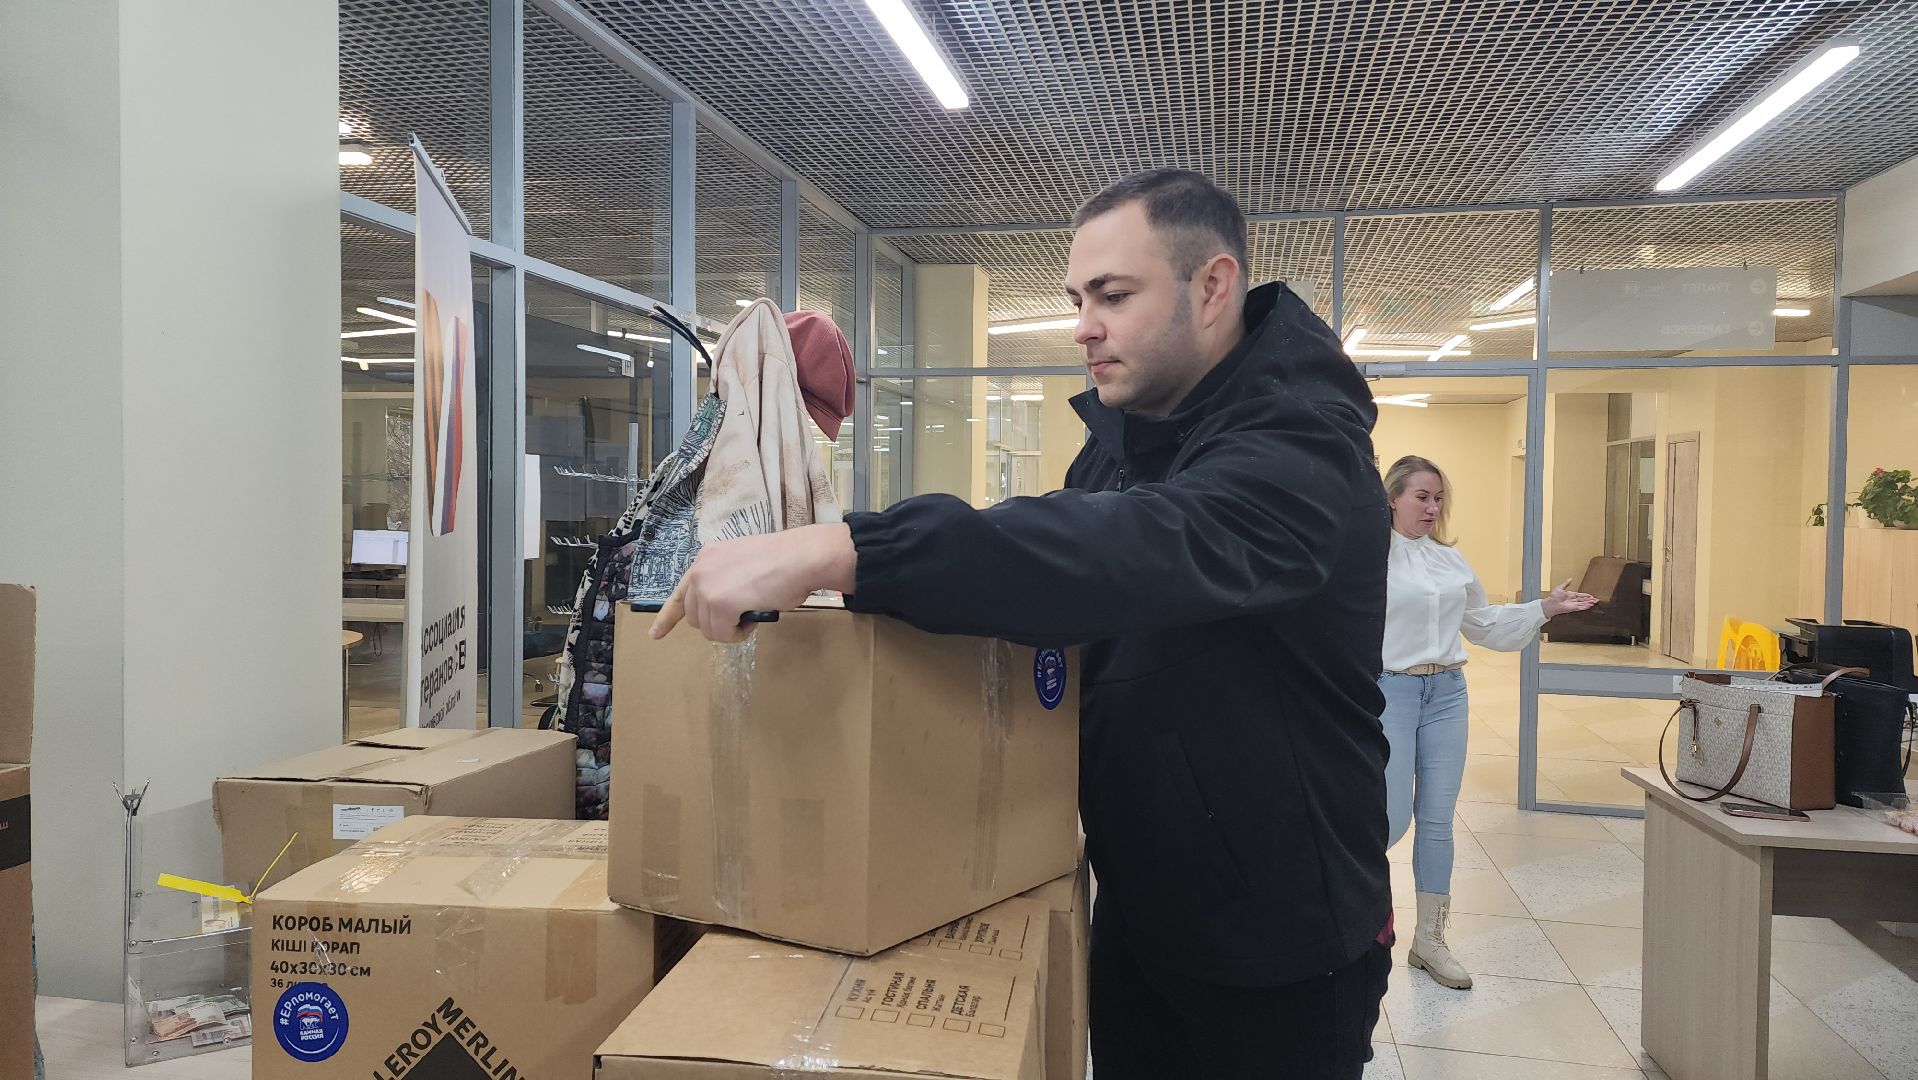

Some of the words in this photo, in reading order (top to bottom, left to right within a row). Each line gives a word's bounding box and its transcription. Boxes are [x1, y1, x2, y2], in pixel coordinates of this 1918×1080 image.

[272, 914, 334, 932] КОРОБ
[338, 914, 411, 935] МАЛЫЙ
[271, 939, 307, 953] КІШІ
[270, 977, 284, 989] 36
[350, 965, 371, 977] см
[846, 978, 867, 1002] КУХНЯ
[880, 971, 905, 1007] ГОСТИНАЯ
[915, 979, 937, 1010] СПАЛЬНЯ
[950, 984, 971, 1017] ДЕТСКАЯ
[279, 991, 340, 1026] #ЕРпомогает
[435, 996, 526, 1080] MERLIN
